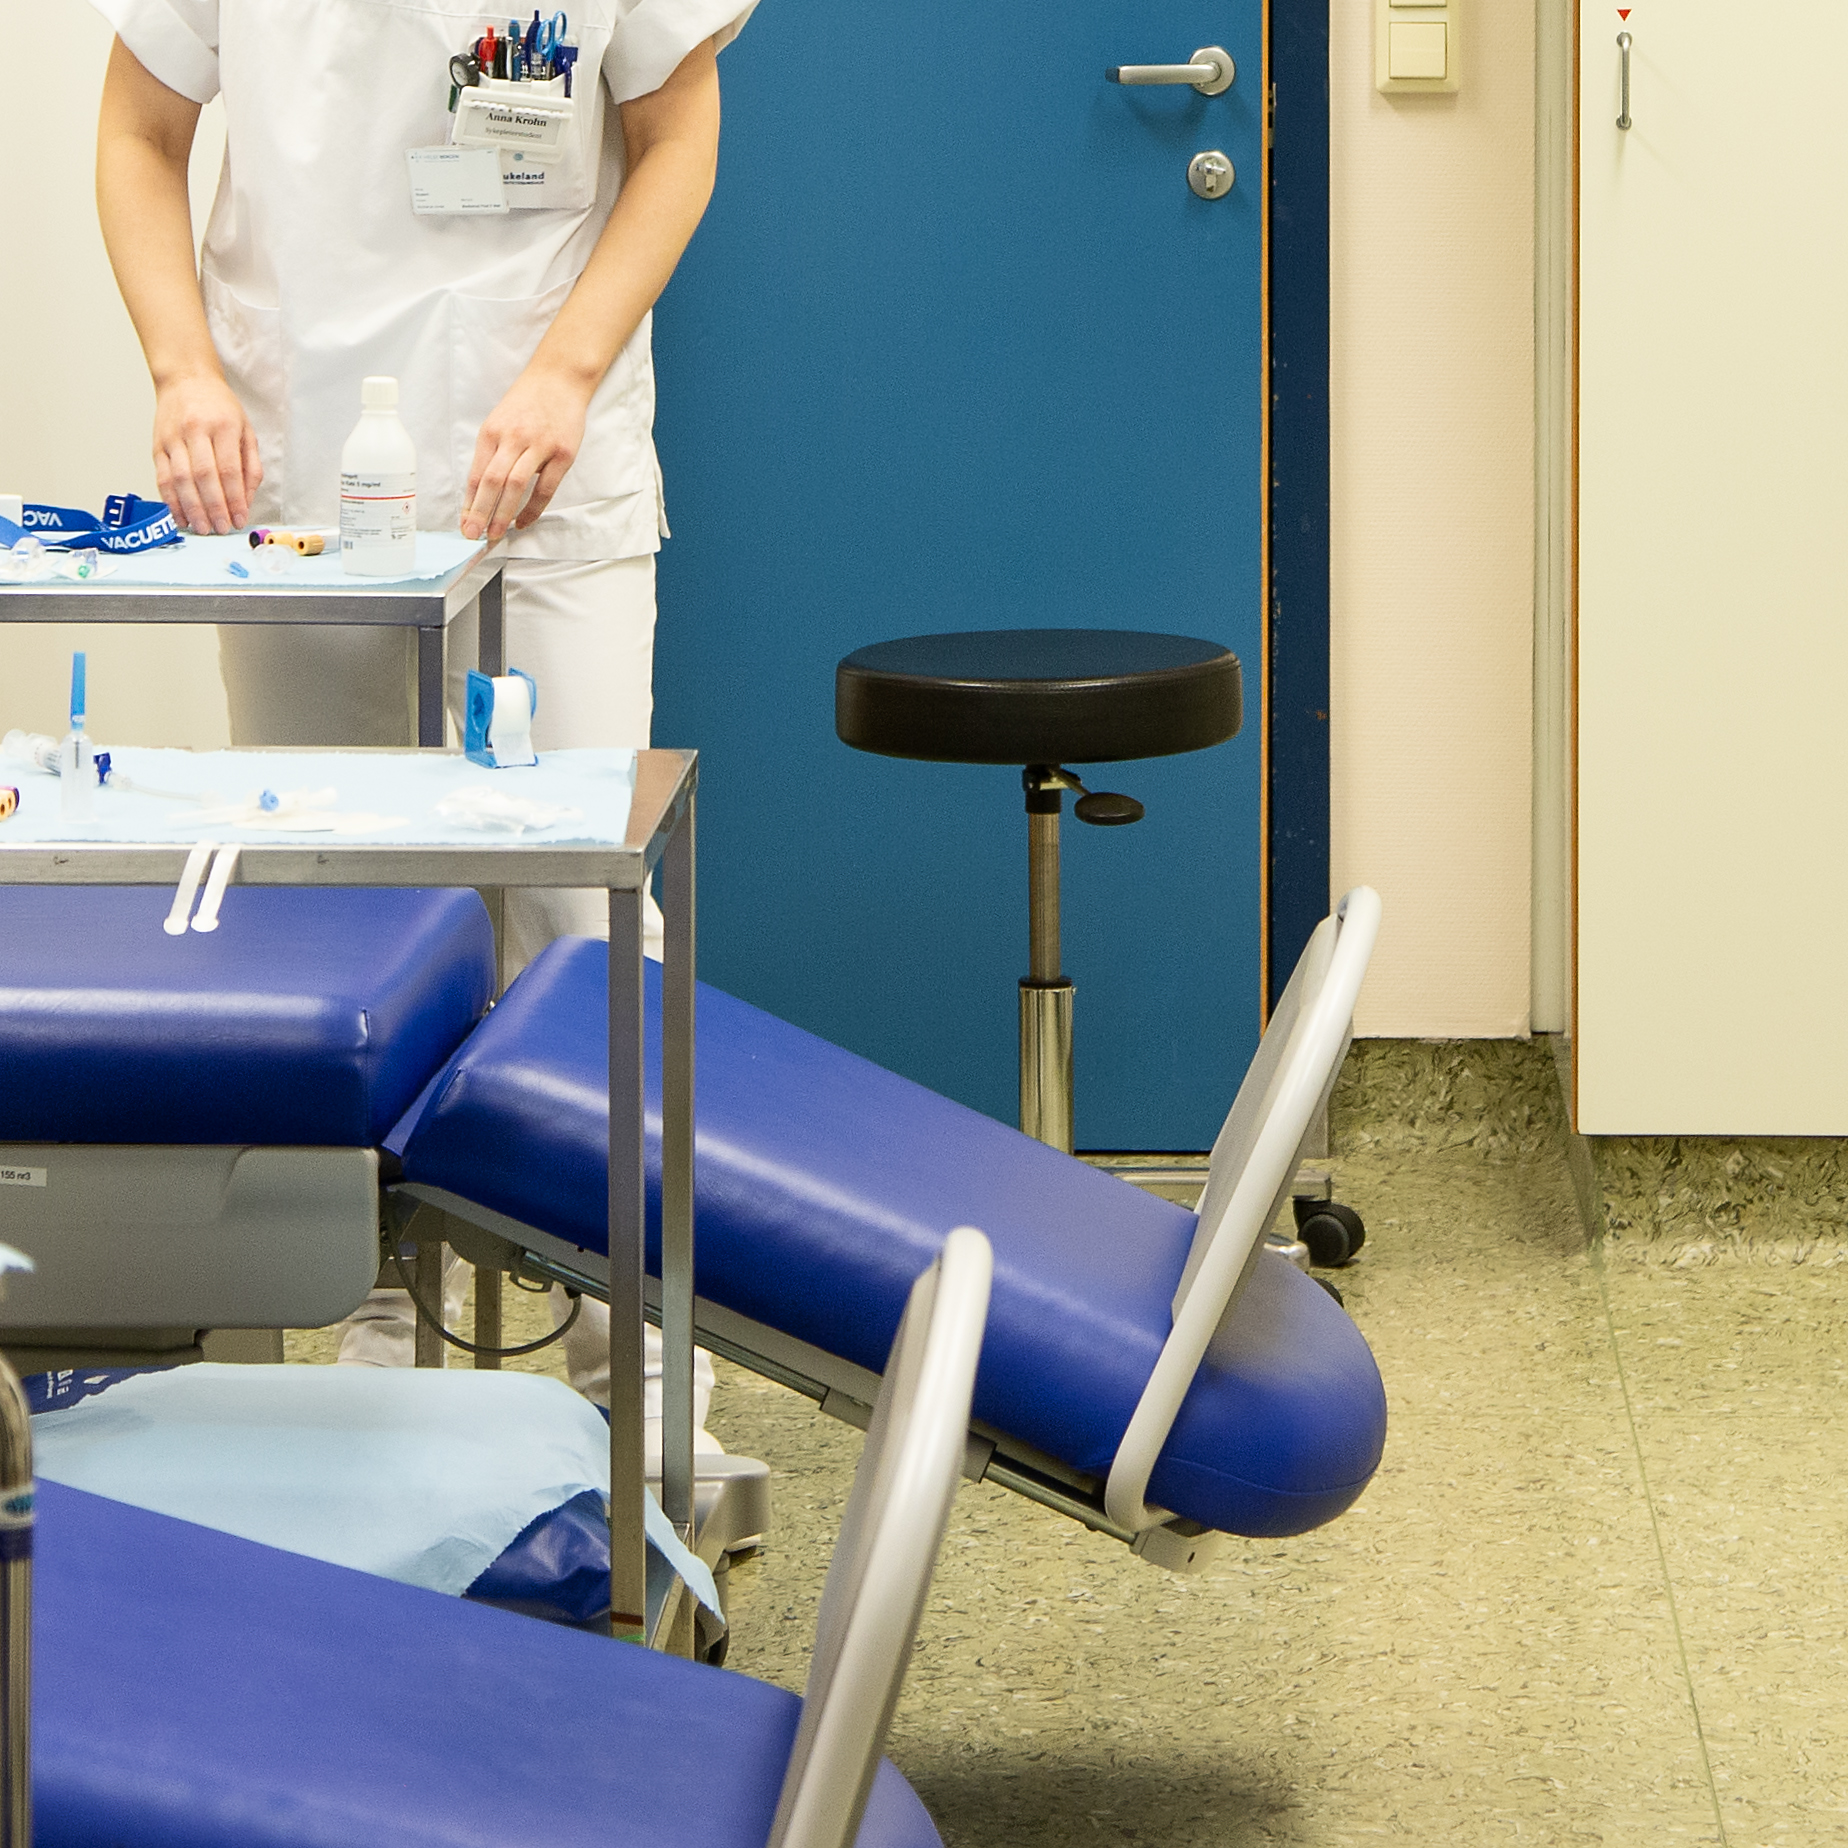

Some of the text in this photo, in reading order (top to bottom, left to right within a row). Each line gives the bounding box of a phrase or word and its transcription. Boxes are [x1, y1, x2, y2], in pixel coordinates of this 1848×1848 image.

[485, 112, 548, 127] Anna Krohn
[1, 1170, 16, 1180] 155
